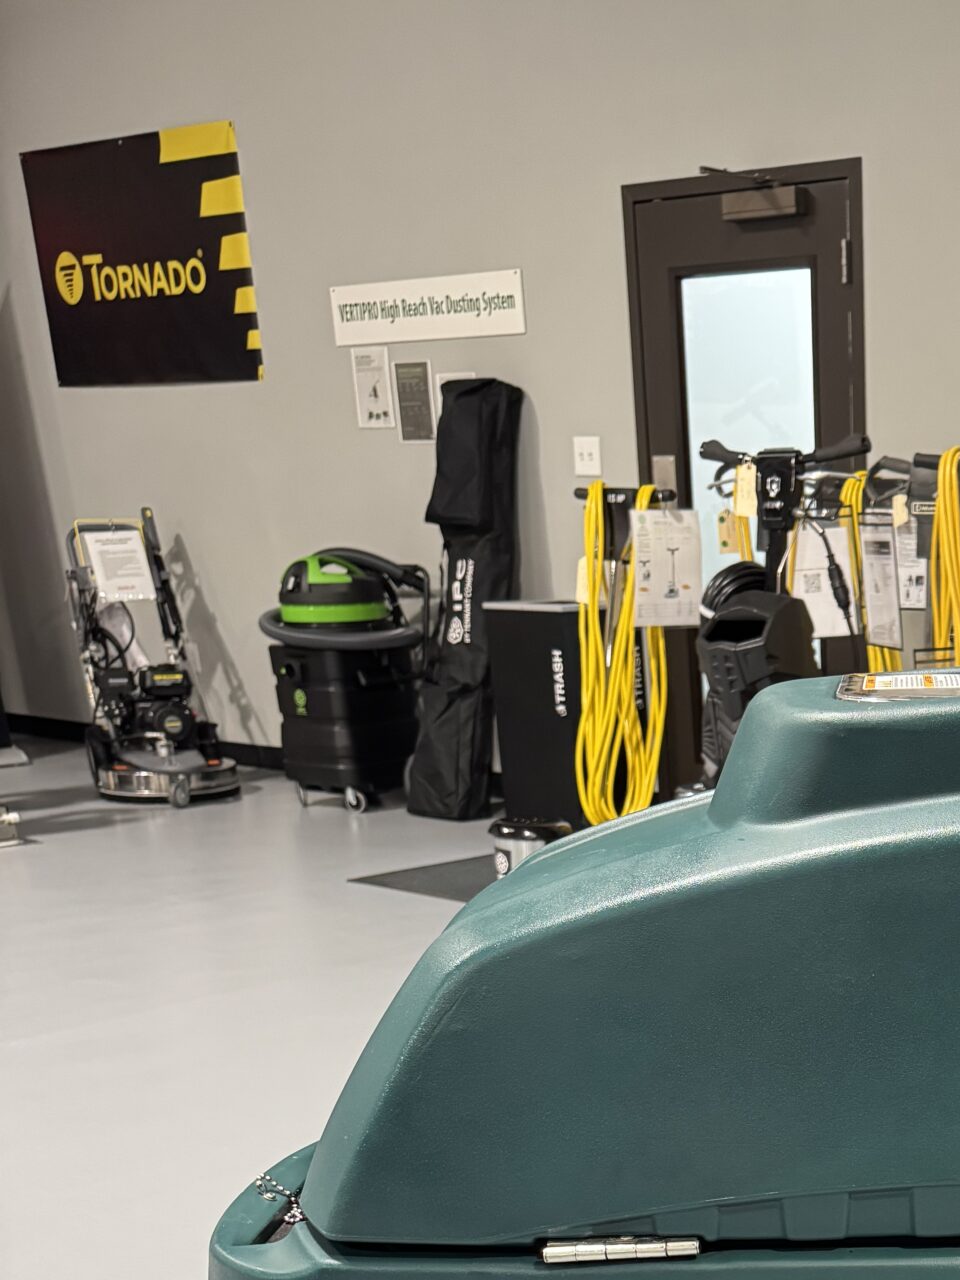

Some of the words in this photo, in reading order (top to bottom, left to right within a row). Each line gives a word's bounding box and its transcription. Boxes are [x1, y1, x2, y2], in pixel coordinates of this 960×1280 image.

[338, 301, 379, 323] VERTIPRO
[379, 299, 401, 324] High
[401, 296, 428, 318] Reach
[428, 296, 445, 316] Vac
[446, 293, 481, 318] Dusting
[481, 291, 516, 317] System
[551, 649, 566, 704] TRASH
